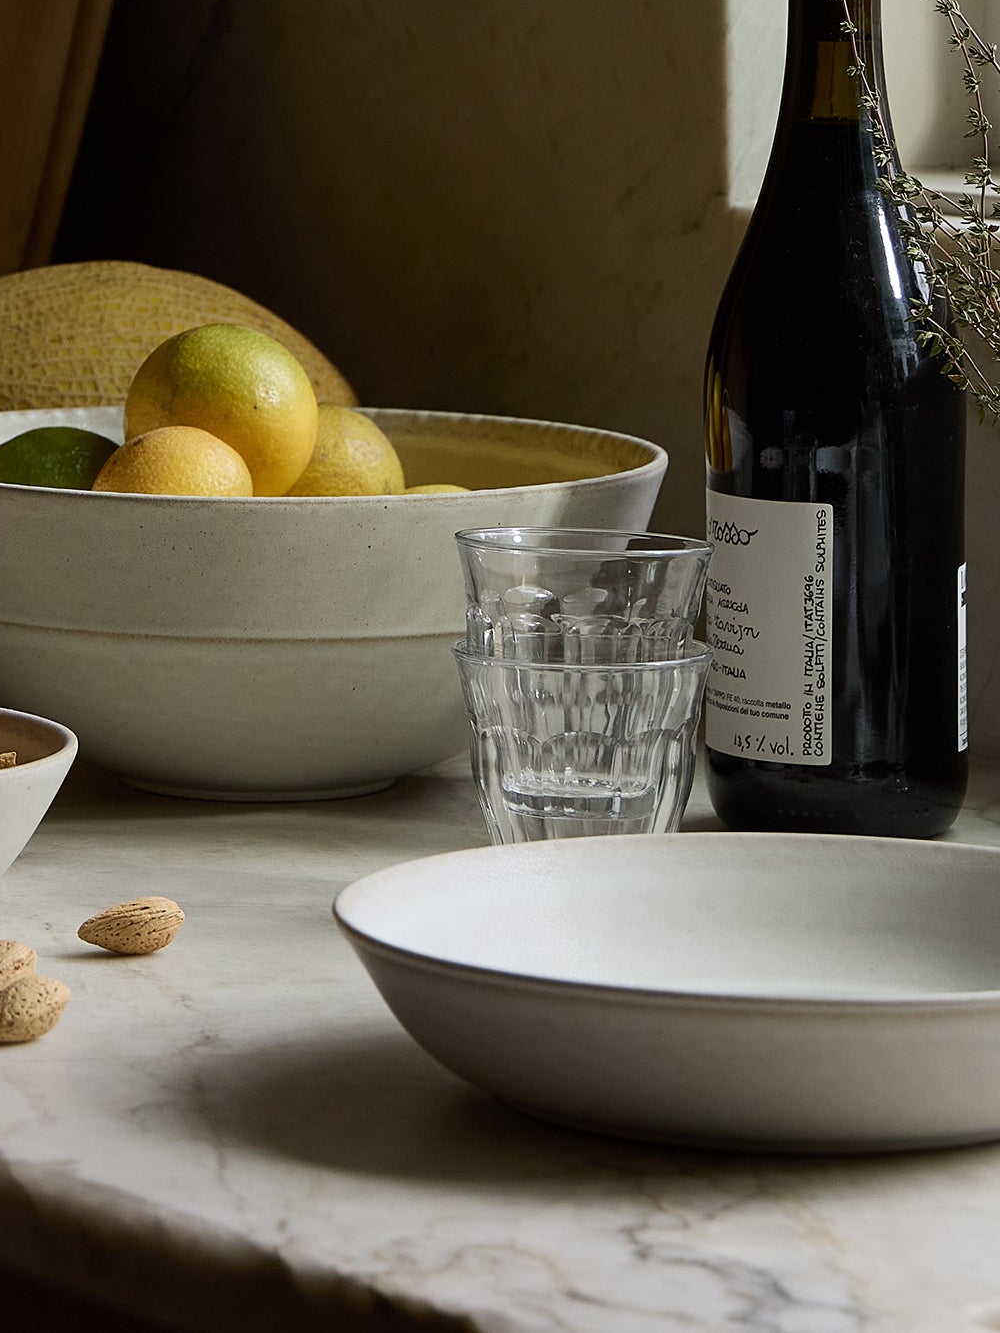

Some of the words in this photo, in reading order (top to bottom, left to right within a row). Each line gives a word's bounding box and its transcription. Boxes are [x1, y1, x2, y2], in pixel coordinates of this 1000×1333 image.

[815, 509, 826, 573] SULPHITES
[803, 683, 813, 696] IN
[740, 707, 748, 715] del
[750, 708, 760, 717] tuo
[761, 710, 789, 720] comune
[742, 698, 764, 708] raccolta
[765, 700, 791, 710] metallo
[802, 702, 813, 756] PRODOTTO
[814, 694, 824, 757] CONTIENE
[734, 734, 751, 752] 13,5
[769, 735, 794, 756] vol.
